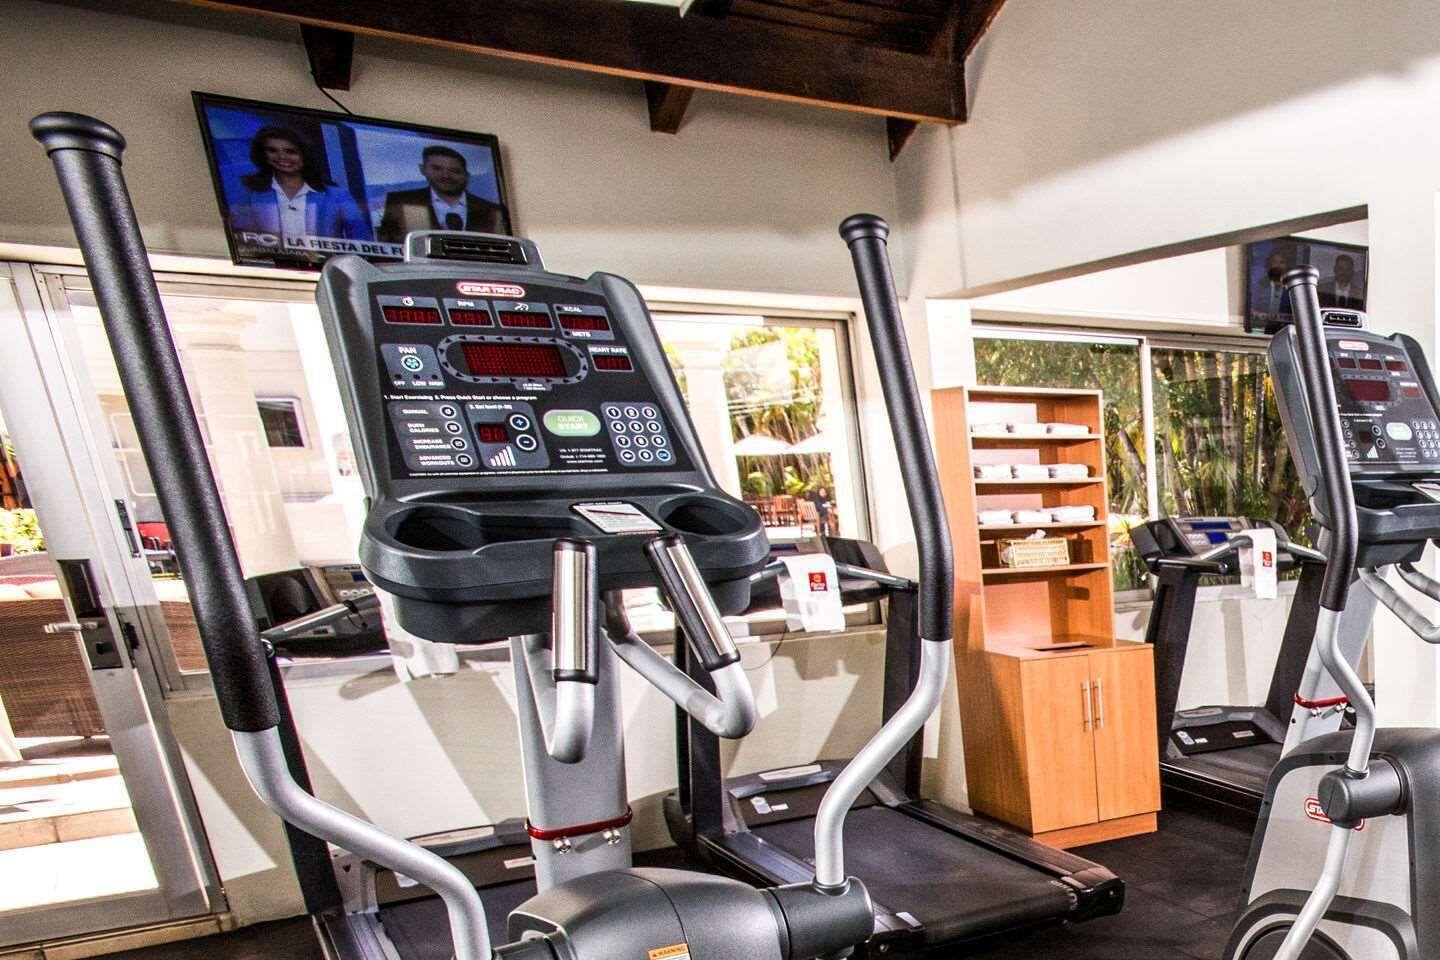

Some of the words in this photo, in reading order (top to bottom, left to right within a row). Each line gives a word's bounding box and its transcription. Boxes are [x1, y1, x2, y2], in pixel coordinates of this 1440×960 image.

[286, 238, 306, 249] LA
[310, 239, 358, 253] FIESTA
[360, 243, 388, 256] DEL
